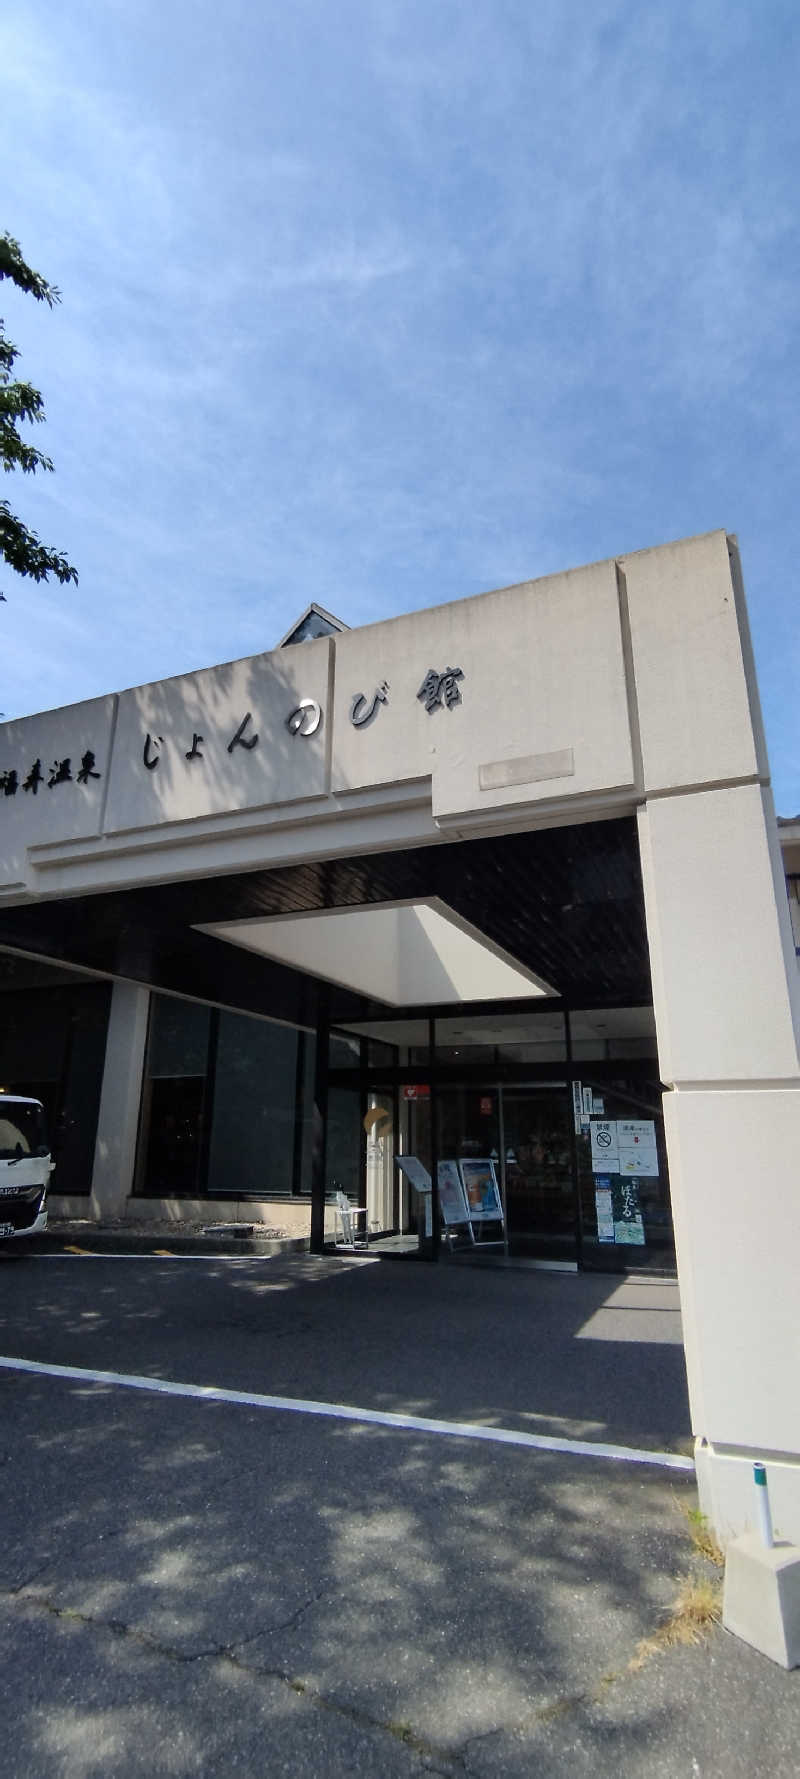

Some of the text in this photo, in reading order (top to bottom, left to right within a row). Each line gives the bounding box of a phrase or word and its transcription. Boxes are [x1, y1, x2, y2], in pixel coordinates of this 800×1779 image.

[143, 665, 466, 771] じょんのび館
